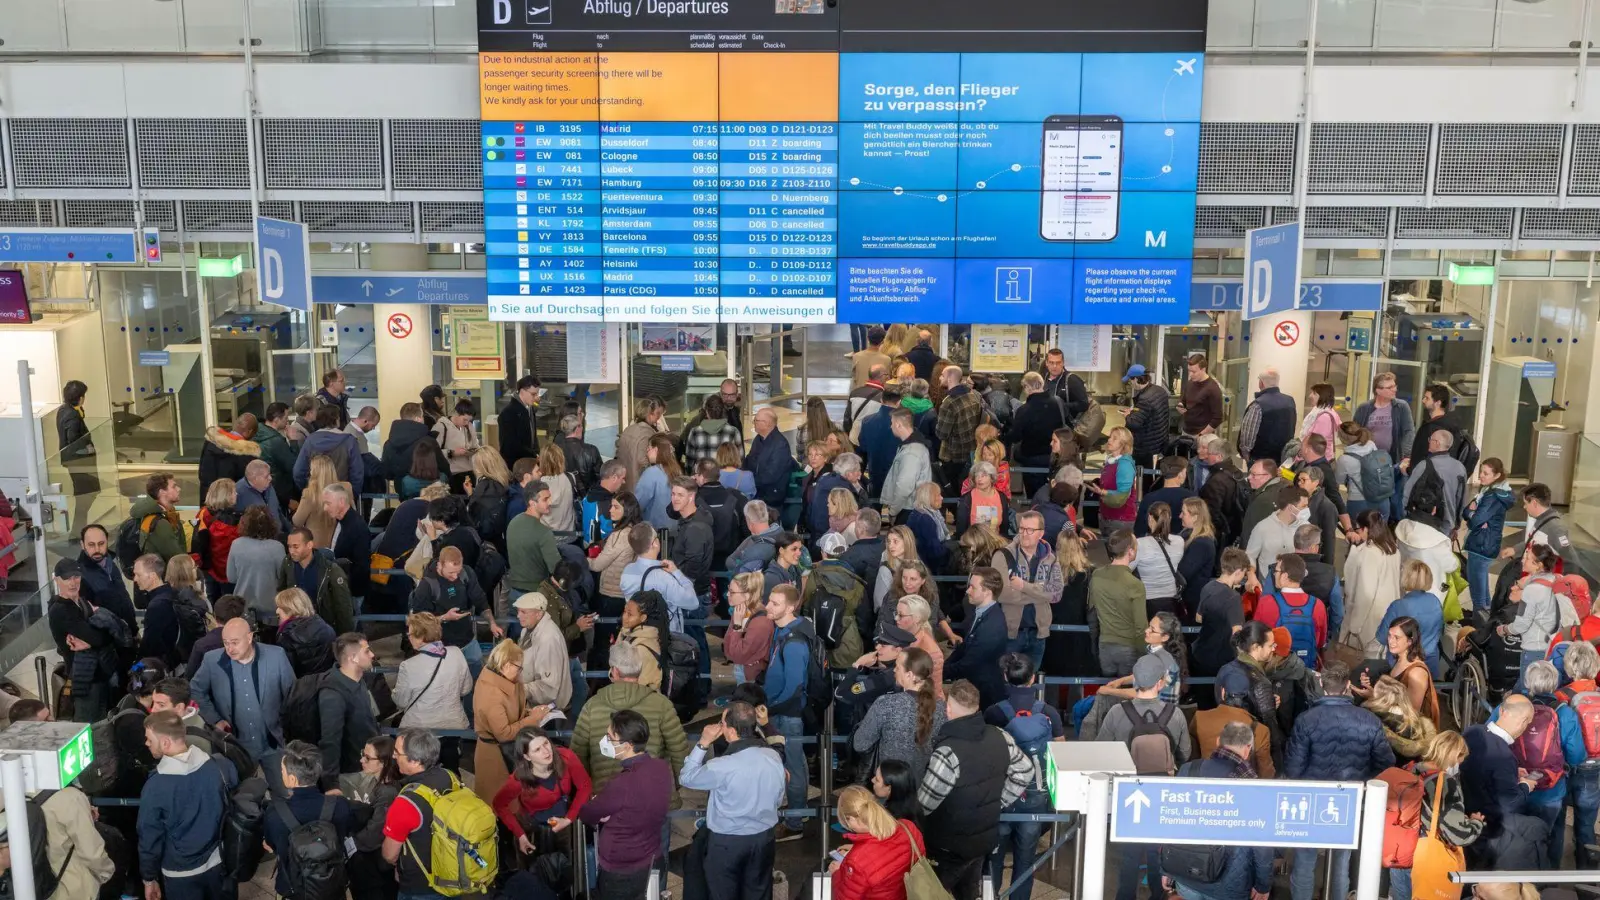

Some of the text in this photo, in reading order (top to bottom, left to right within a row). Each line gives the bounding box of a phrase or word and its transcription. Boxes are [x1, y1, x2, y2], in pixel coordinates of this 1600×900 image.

[493, 0, 511, 24] D
[584, 0, 728, 17] Abflug Departures
[484, 55, 608, 64] Due to industrial action at the
[484, 69, 662, 79] passenger security screening there will be
[484, 83, 570, 93] longer waiting times.
[865, 84, 1018, 98] Sorge, den Flieger
[485, 97, 645, 107] We kindly ask for your understanding.
[865, 100, 986, 113] zu verpassen?
[906, 123, 931, 131] Buddy
[961, 123, 973, 131] du,
[602, 153, 637, 161] Cologne
[783, 153, 821, 161] boarding
[602, 179, 641, 188] Hamburg
[602, 207, 646, 215] Arvidsjaur
[261, 224, 285, 237] Terminal
[1145, 230, 1166, 247] M
[1256, 233, 1280, 247] Terminal
[540, 246, 552, 254] DE
[563, 246, 584, 254] 1584
[263, 247, 283, 298] D
[418, 278, 448, 291] Abflug
[882, 277, 925, 285] Fluganzeigen
[1252, 260, 1272, 312] D
[418, 290, 469, 302] Departures
[541, 286, 552, 294] AF
[564, 286, 585, 294] 1423
[1212, 285, 1226, 306] D
[1085, 296, 1117, 304] departure
[502, 304, 823, 317] Sie auf Durchsagen und folgen Sie den Anweisungen
[1161, 790, 1234, 804] Fast Track
[1160, 807, 1238, 817] First, Business and
[1160, 816, 1266, 829] Premium Passengers only
